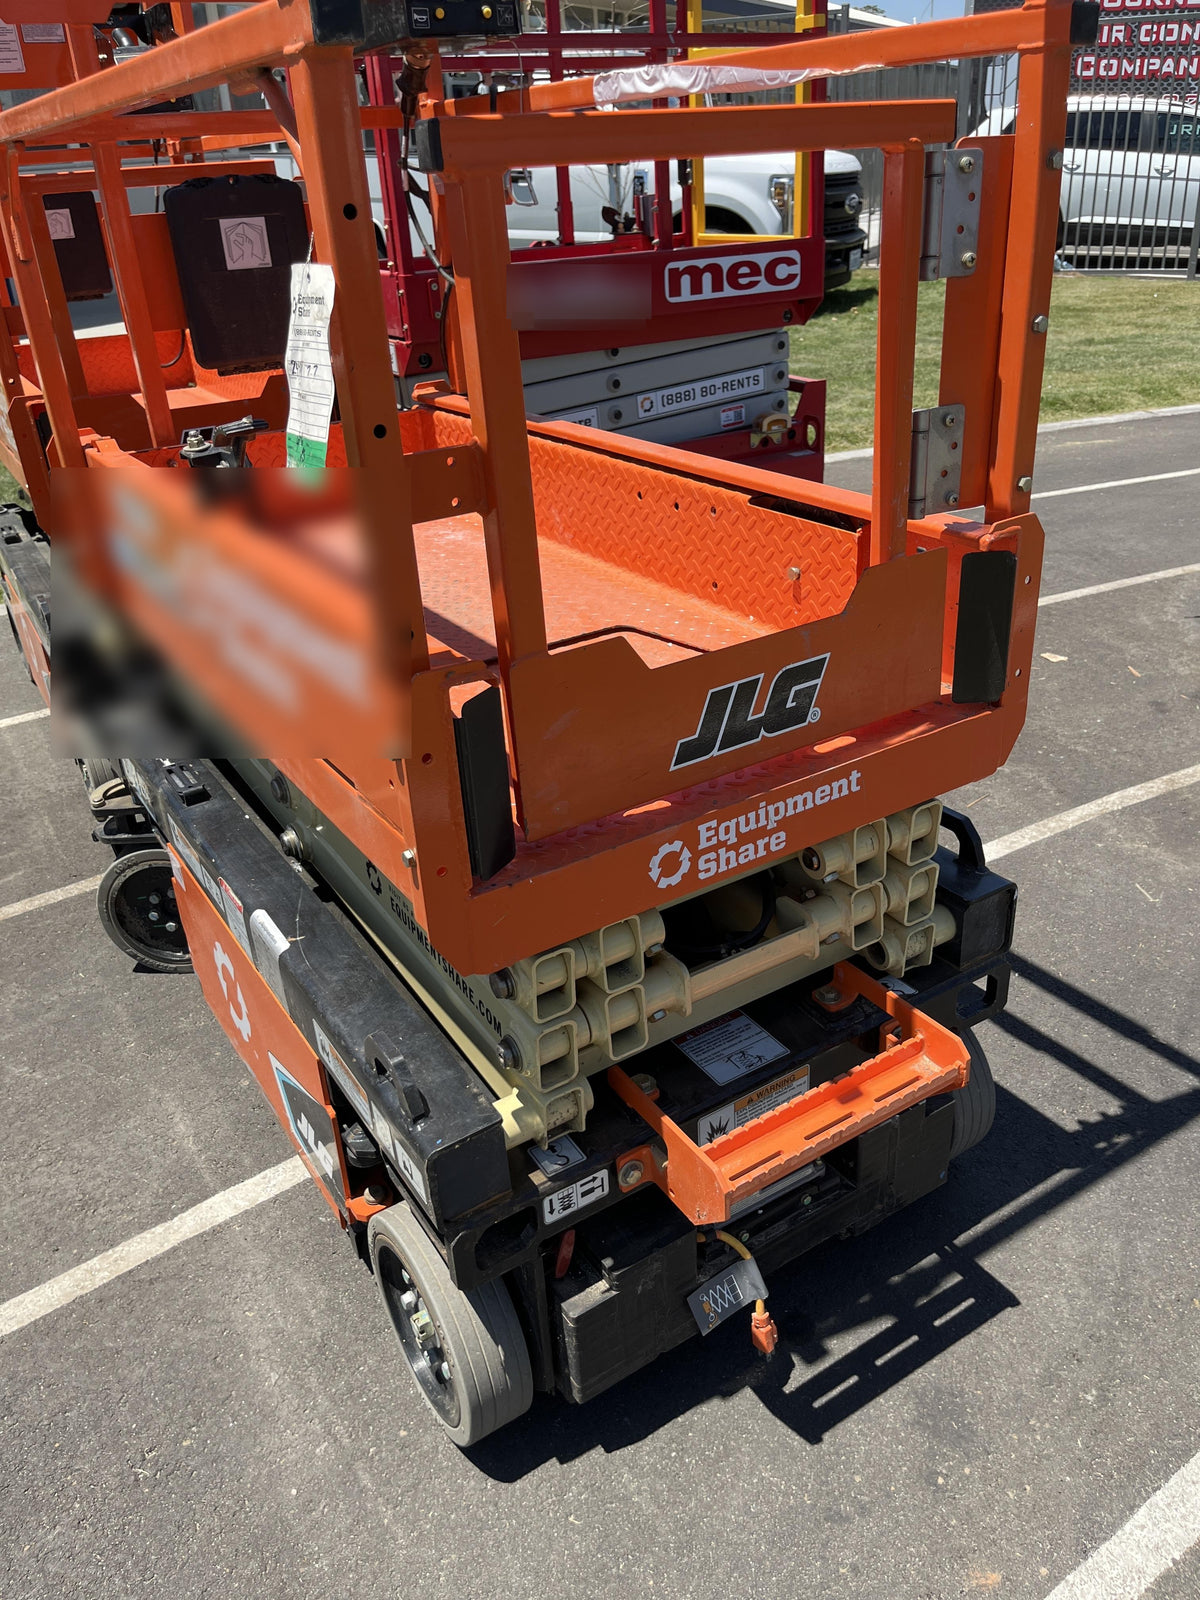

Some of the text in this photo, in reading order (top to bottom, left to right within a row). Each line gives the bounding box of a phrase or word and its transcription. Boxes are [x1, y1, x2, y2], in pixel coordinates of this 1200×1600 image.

[1098, 25, 1128, 43] IR
[668, 256, 799, 298] mec
[661, 373, 761, 408] (888) 80-RENTS
[697, 769, 862, 850] Equipment
[697, 830, 787, 881] Share
[296, 1111, 334, 1180] JLG
